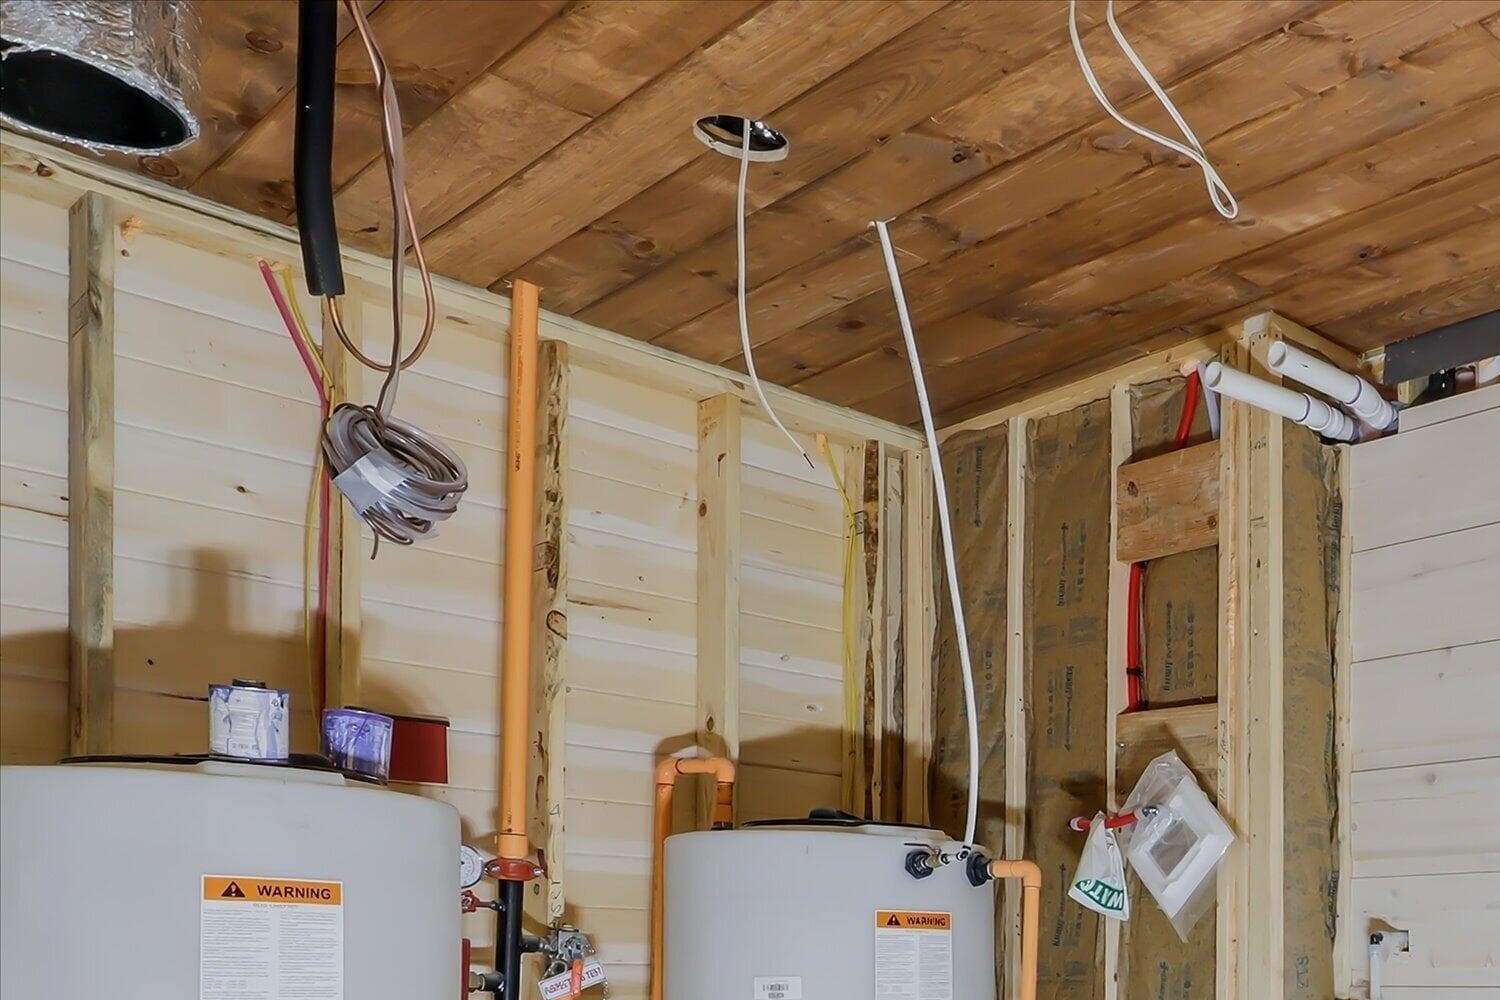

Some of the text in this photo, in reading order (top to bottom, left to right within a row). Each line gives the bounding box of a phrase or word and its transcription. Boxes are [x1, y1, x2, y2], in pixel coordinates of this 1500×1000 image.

[257, 884, 331, 900] WARNING
[906, 916, 946, 927] WARNING
[586, 966, 603, 980] TEST
